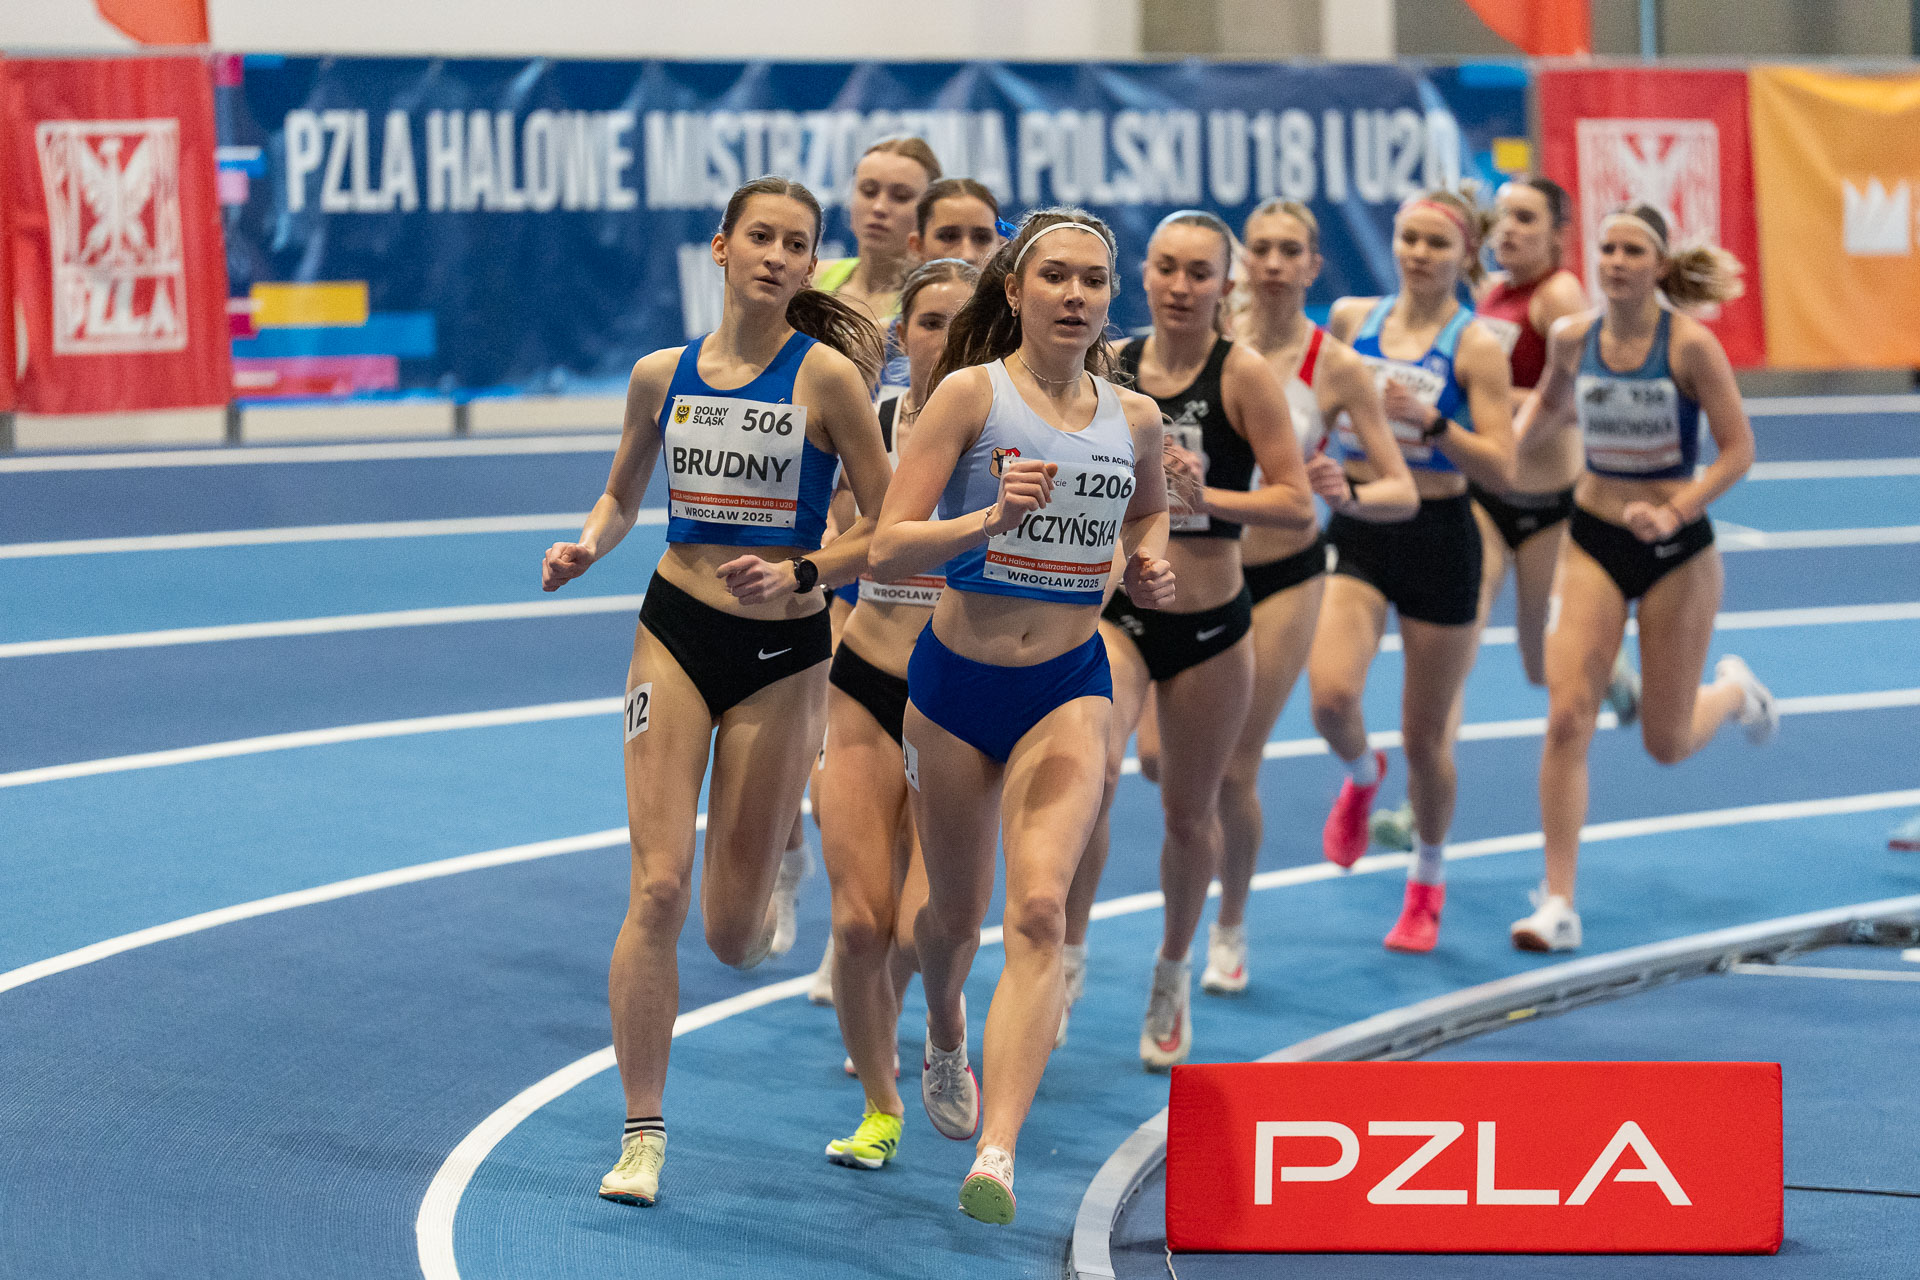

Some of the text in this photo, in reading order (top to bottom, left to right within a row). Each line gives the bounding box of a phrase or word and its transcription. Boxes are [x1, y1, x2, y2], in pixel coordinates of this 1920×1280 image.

[285, 109, 418, 213] PZLA
[426, 109, 638, 213] HALOWE
[1018, 107, 1201, 206] POLSKI
[1208, 108, 1317, 204] U18
[1353, 108, 1462, 202] U20
[692, 414, 725, 427] ŚLĄSK
[694, 405, 730, 417] DOLNY
[741, 408, 793, 436] 506
[673, 446, 792, 483] BRUDNY
[1091, 454, 1110, 463] UKS
[1074, 472, 1133, 500] 1206
[700, 495, 739, 505] Mistrzostwa
[740, 498, 761, 507] Polski
[684, 506, 773, 523] WROCŁAW 2025
[1002, 512, 1117, 548] YCZYŃSKA
[990, 553, 1007, 563] PZLA
[1008, 557, 1036, 568] Halowe
[1036, 561, 1077, 573] Mistrzostwa
[1007, 570, 1100, 589] WROCŁAW 2025
[626, 691, 649, 733] 12
[1254, 1120, 1693, 1206] PZLA
